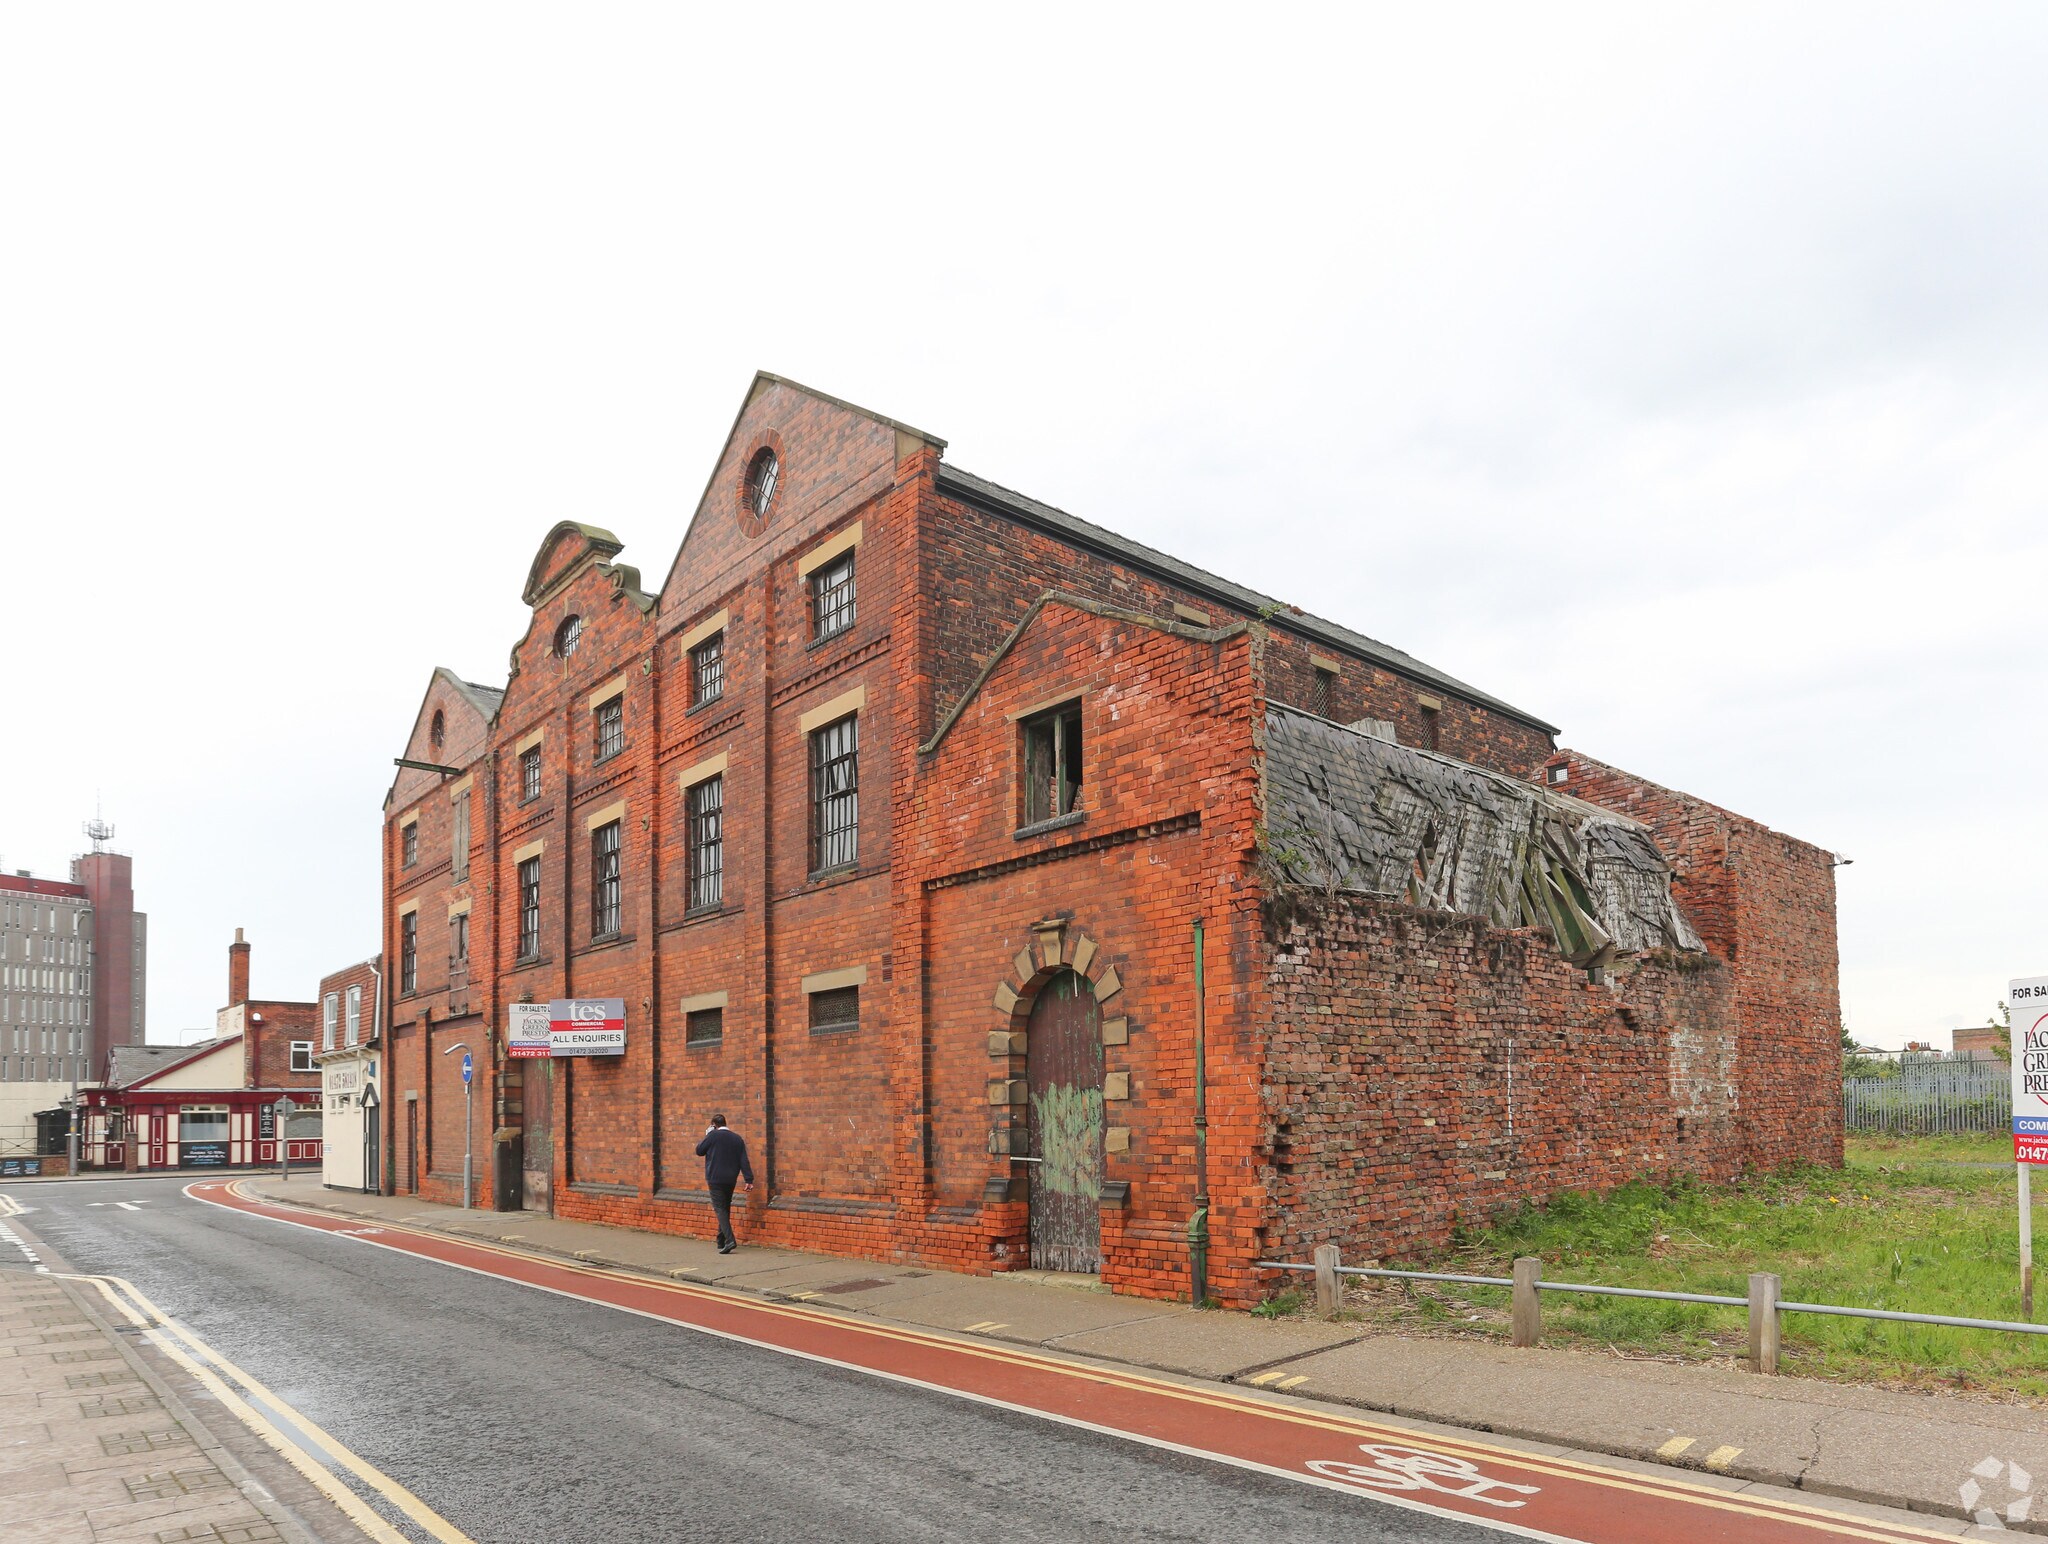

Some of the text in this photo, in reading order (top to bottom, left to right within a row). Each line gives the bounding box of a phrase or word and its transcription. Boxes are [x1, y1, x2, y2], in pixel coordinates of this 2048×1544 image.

[2012, 985, 2048, 999] FOR SA
[568, 1001, 606, 1021] tes
[573, 1034, 621, 1043] ENQUIRIES
[2019, 1120, 2048, 1131] COM
